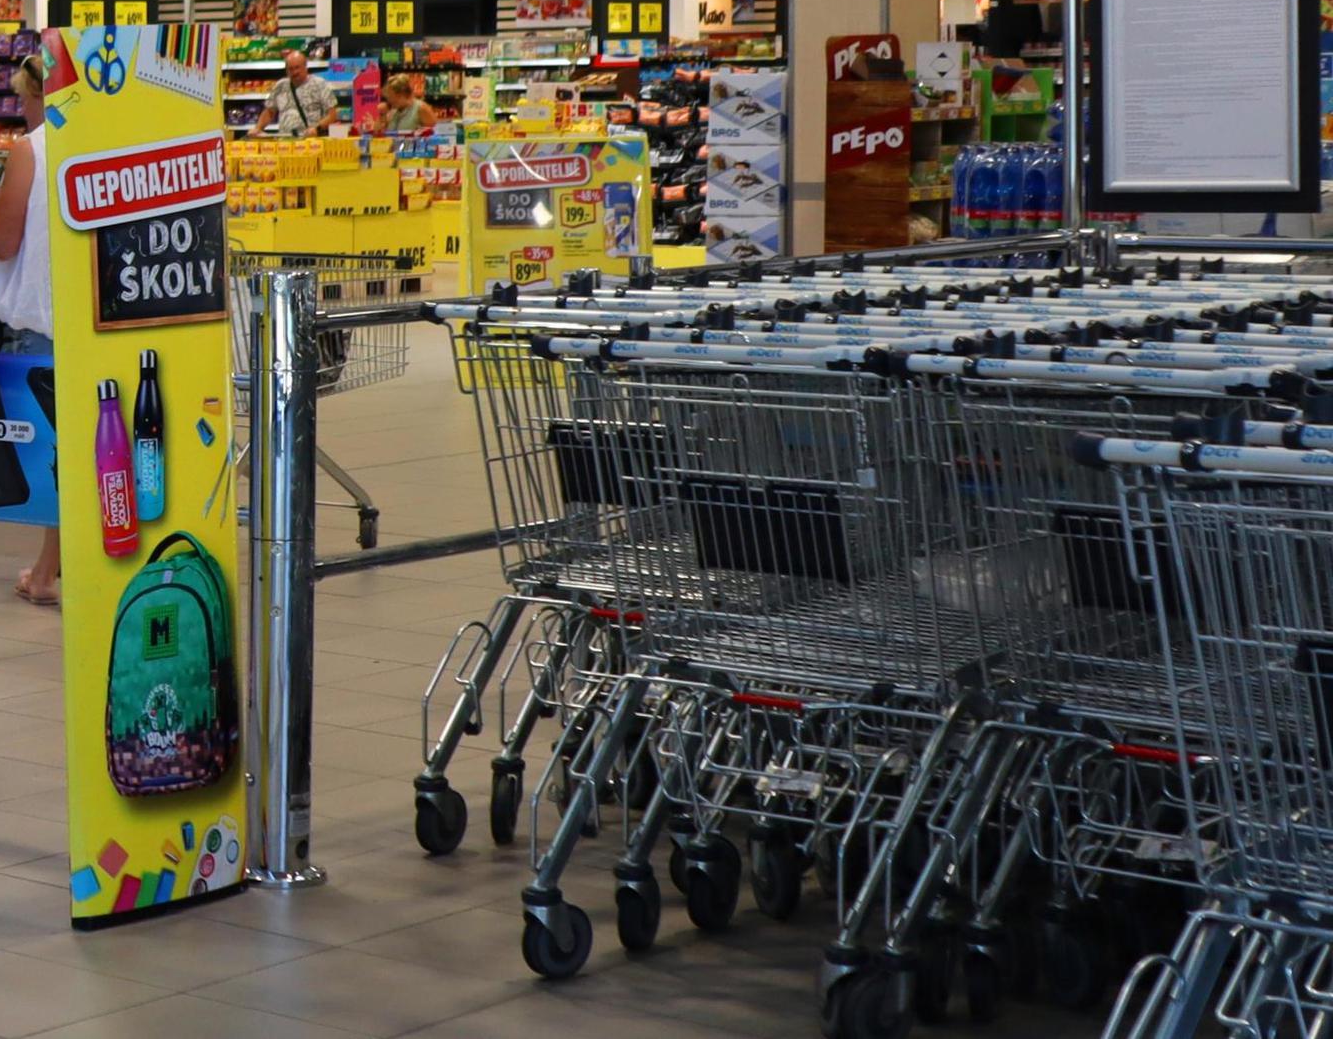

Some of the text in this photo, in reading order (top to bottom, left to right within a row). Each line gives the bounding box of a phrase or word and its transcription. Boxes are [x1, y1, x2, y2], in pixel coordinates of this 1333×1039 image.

[834, 40, 893, 81] PEO
[711, 128, 740, 138] BROS
[832, 126, 904, 155] PEPO
[75, 140, 224, 211] NEPORAZITELNÉ
[486, 159, 581, 184] NEPORAZITELNÉ
[509, 193, 531, 206] DO
[709, 200, 738, 209] BROS
[149, 217, 193, 255] DO
[119, 251, 216, 302] ŠKOLY
[150, 617, 170, 646] M
